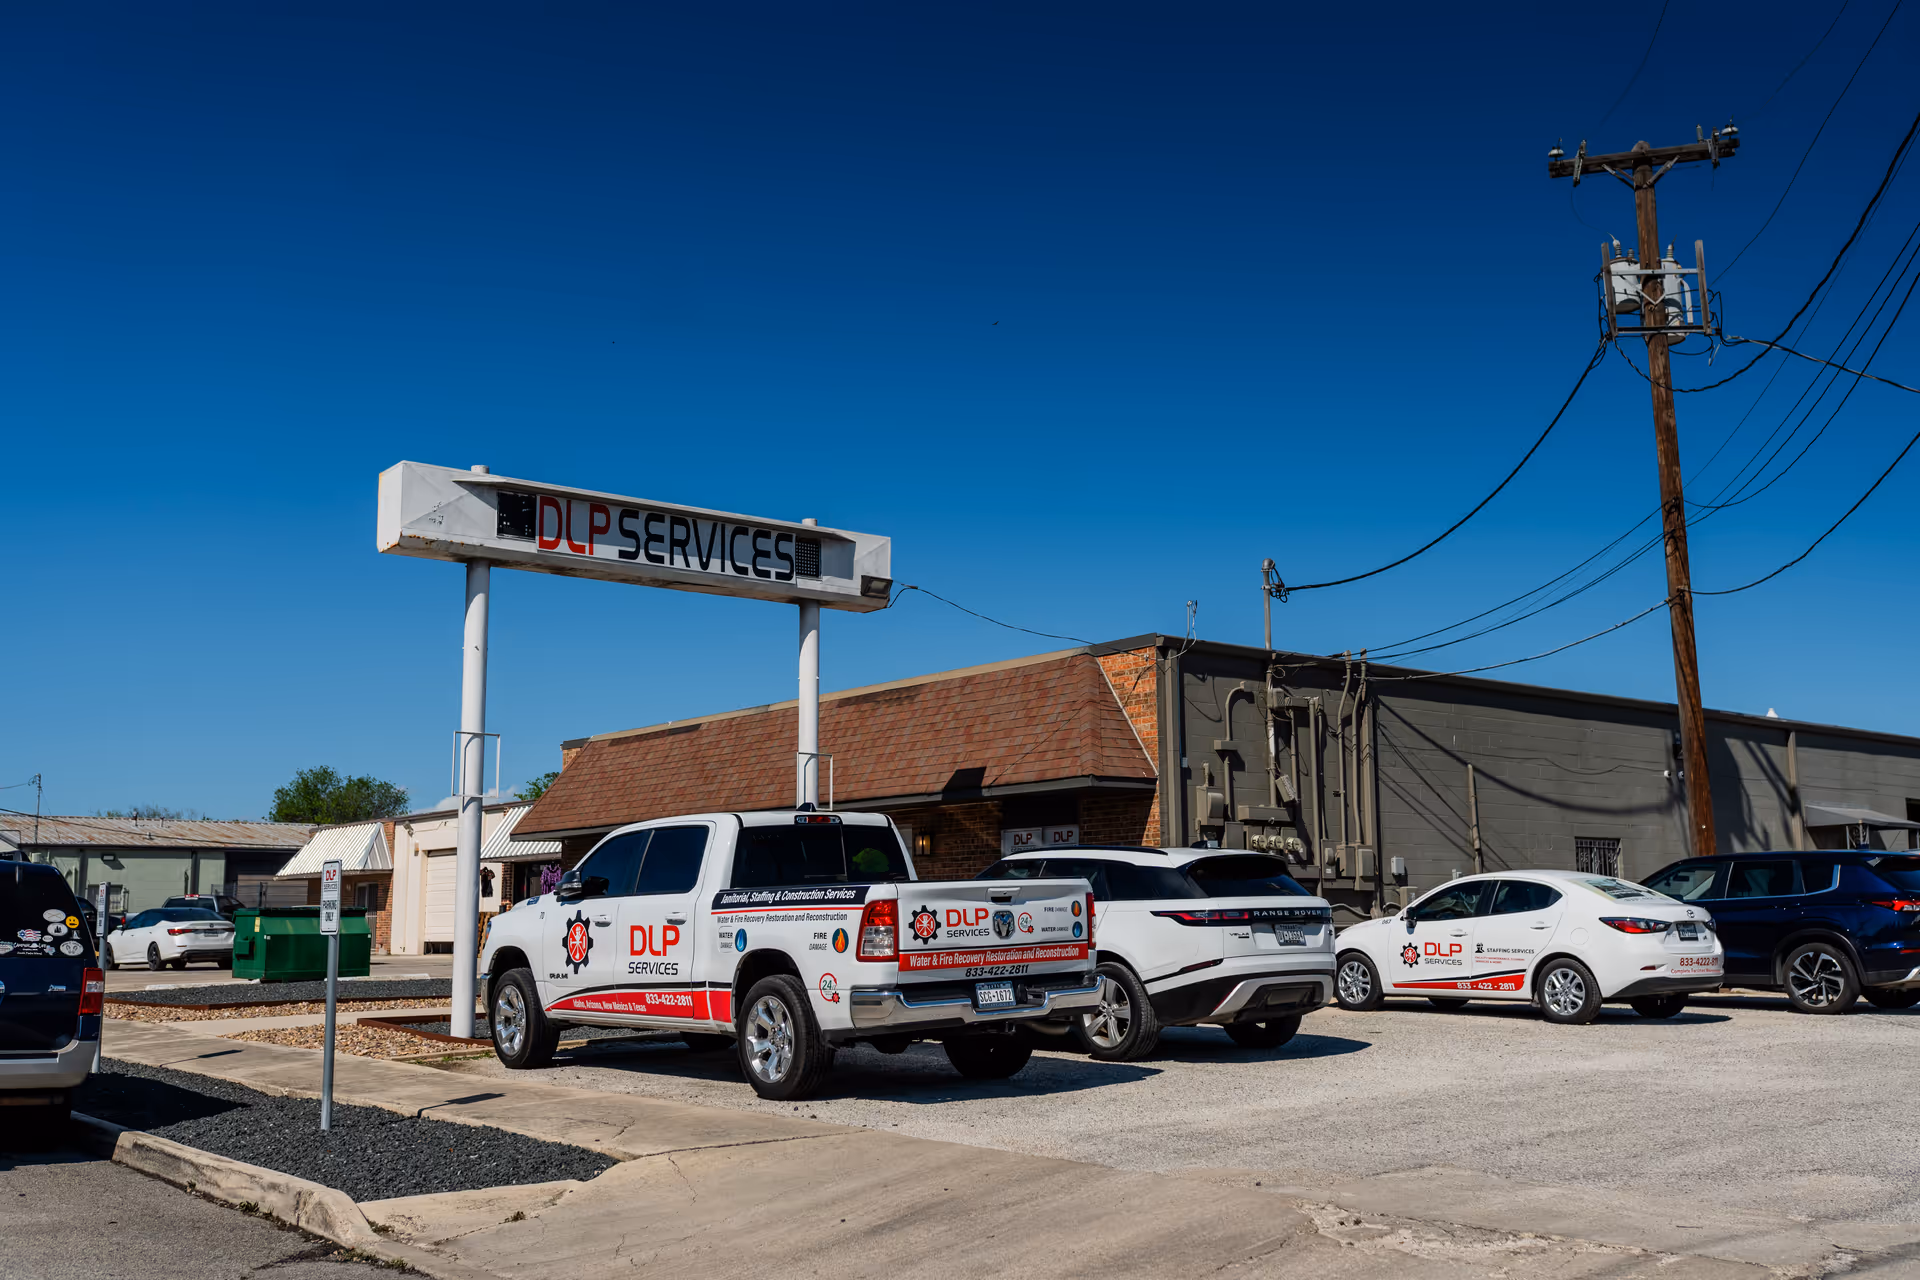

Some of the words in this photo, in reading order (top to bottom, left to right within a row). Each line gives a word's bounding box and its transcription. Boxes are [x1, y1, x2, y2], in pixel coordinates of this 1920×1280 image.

[538, 496, 611, 556] DLP
[618, 508, 795, 582] SERVICES
[1013, 833, 1033, 845] DLP
[1053, 830, 1074, 843] DLP
[325, 869, 337, 881] DLP
[721, 891, 750, 904] Janitorial,
[750, 891, 775, 903] Staffing
[775, 891, 781, 901] &
[781, 889, 824, 901] Construction
[824, 888, 857, 899] Services
[717, 916, 730, 924] Water
[734, 915, 743, 923] Fire
[743, 914, 765, 924] Recovery
[765, 913, 795, 922] Restoration
[795, 913, 805, 921] and
[805, 912, 848, 921] Reconstruction
[946, 907, 989, 928] DLP
[813, 932, 828, 940] FIRE
[946, 928, 990, 939] SERVICES
[630, 924, 681, 957] DLP
[808, 943, 828, 951] DAMAGE
[909, 954, 931, 967] Water
[932, 954, 938, 966] &
[939, 953, 953, 965] Fire
[953, 952, 985, 966] Recovery
[986, 949, 1022, 963] Restoration
[1022, 948, 1035, 960] and
[1034, 945, 1080, 959] Reconstruction
[1424, 942, 1462, 957] DLP
[628, 961, 679, 976] SERVICES
[1424, 958, 1463, 966] SERVICES
[965, 964, 1029, 978] 833-422-2811
[1456, 982, 1471, 990] 833
[1478, 982, 1493, 990] 422
[572, 999, 586, 1009] Idaho,
[586, 1000, 603, 1010] Arizona,
[603, 1001, 613, 1010] New
[612, 1002, 628, 1011] Mexico
[628, 1003, 633, 1011] &
[633, 1003, 647, 1012] Texas
[645, 993, 693, 1007] 833-422-2811
